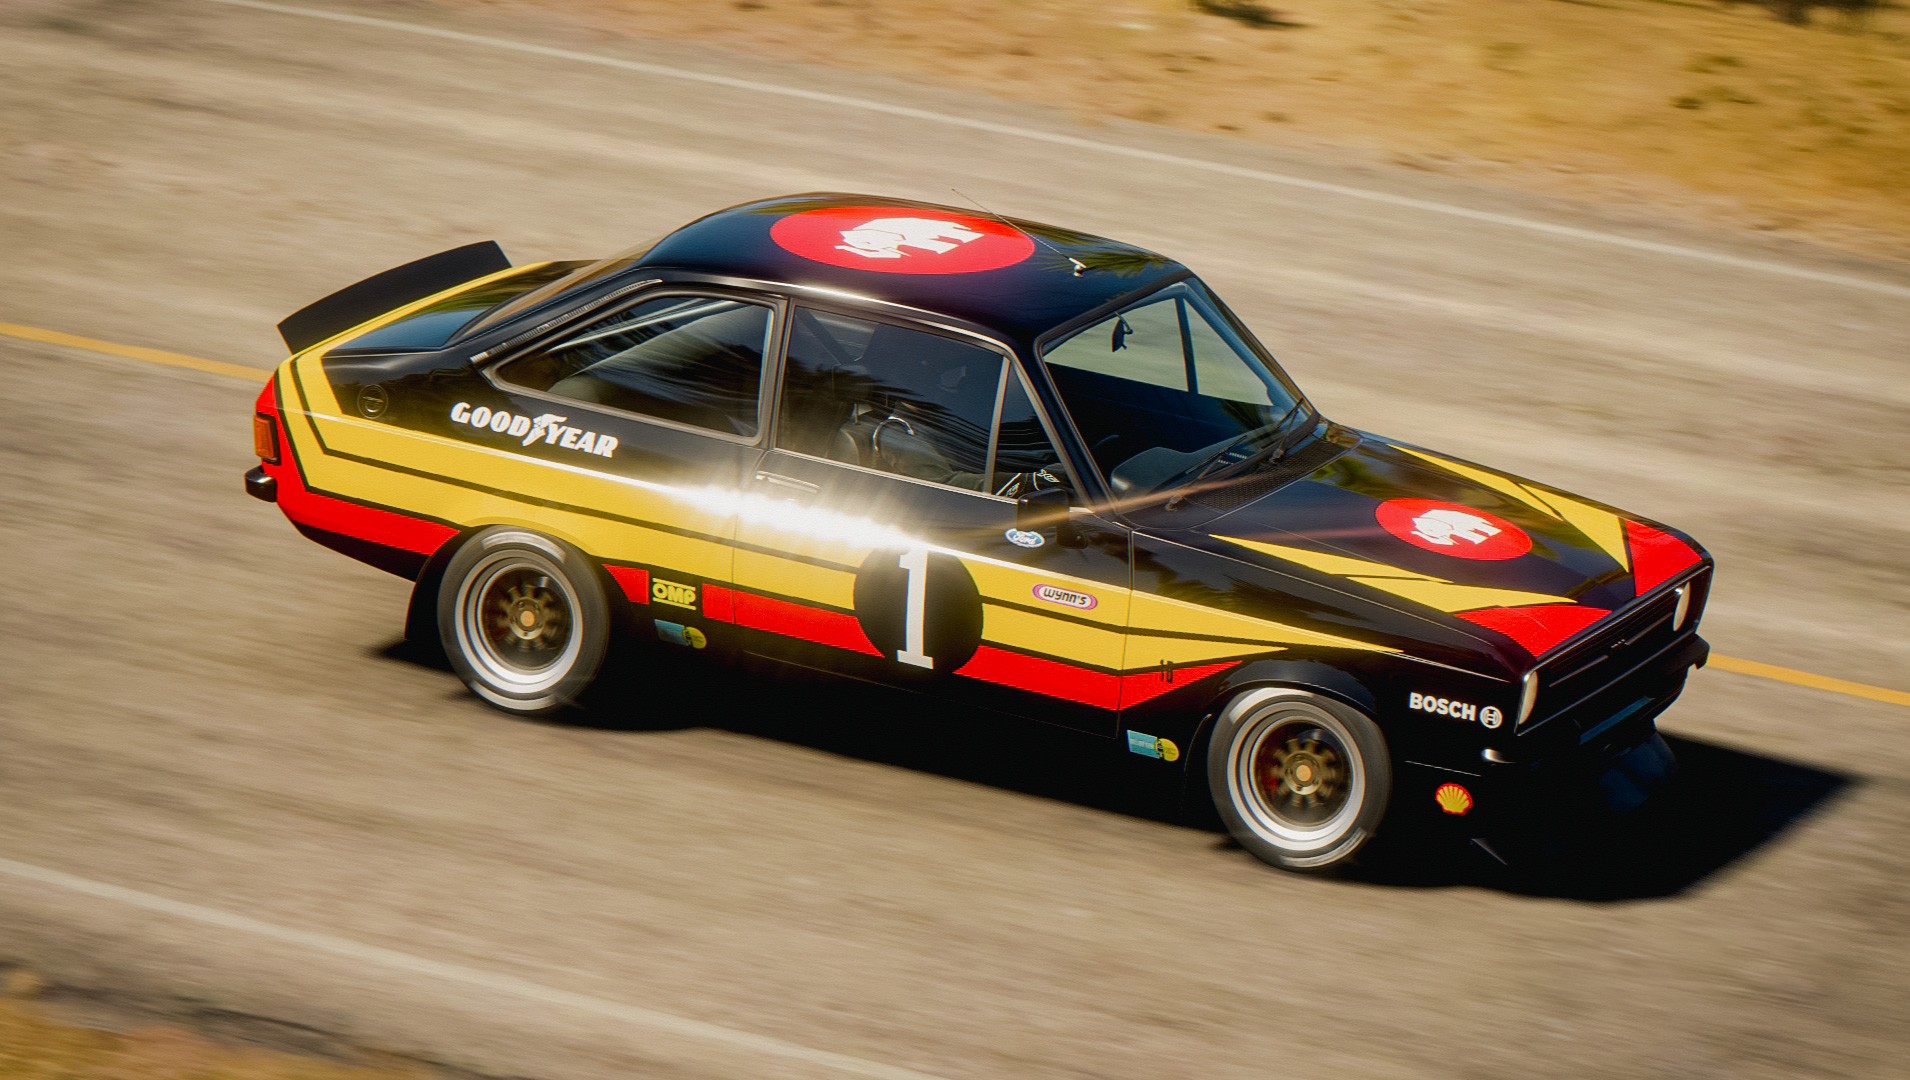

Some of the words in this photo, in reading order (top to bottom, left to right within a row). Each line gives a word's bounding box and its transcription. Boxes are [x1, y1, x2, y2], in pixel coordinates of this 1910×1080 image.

[652, 583, 696, 605] OMP
[896, 543, 934, 670] 1
[1409, 692, 1477, 721] BOSCH
